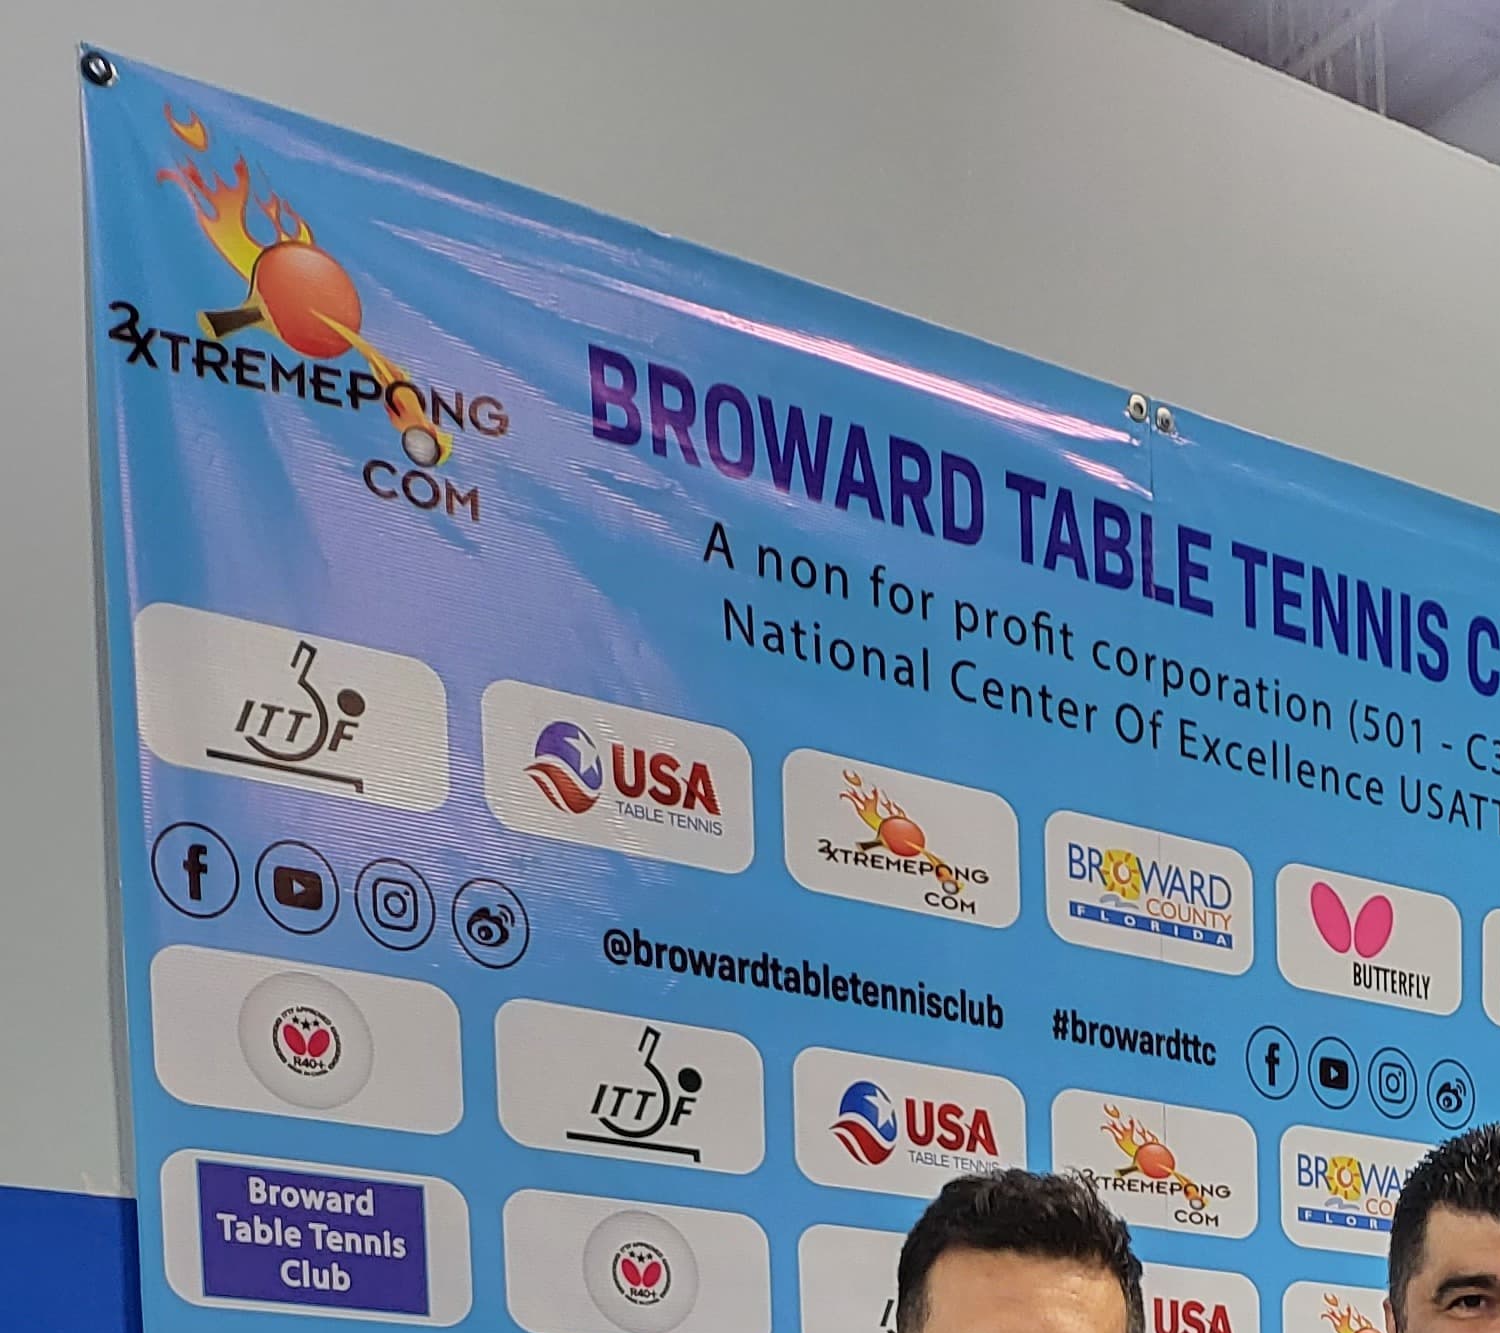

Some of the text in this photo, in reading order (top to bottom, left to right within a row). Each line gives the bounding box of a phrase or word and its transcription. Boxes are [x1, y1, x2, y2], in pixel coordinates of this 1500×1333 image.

[362, 459, 481, 522] COM
[587, 343, 985, 546] BROWARD
[1004, 469, 1214, 617] TABLE
[1231, 539, 1450, 682] TENNIS
[703, 522, 734, 569] A
[757, 543, 849, 598] non
[872, 565, 935, 620] for
[955, 598, 1074, 661] profit
[1092, 638, 1332, 730] corporation
[1348, 698, 1423, 755] (501
[724, 598, 930, 691] National
[950, 660, 1098, 733] Center
[1115, 701, 1163, 749] Of
[1180, 722, 1384, 806] Excellence
[612, 742, 722, 817] USA
[615, 800, 723, 837] TABLE TENNIS
[1068, 842, 1232, 911] BROWARD
[924, 891, 976, 915] COM
[1146, 898, 1232, 931] COUNTY
[1077, 905, 1228, 946] FLORIDA
[603, 928, 1217, 1067] @browardtabletennisclub #browardttc
[1352, 961, 1431, 1000] BUTTERFLY
[905, 1098, 999, 1157] USA
[908, 1150, 950, 1168] TABLE
[1298, 1153, 1412, 1197] BROWA
[248, 1176, 374, 1217] Broward
[216, 1212, 407, 1258] Table Tennis
[1174, 1209, 1219, 1228] COM
[1304, 1211, 1379, 1230] FLOR
[280, 1258, 352, 1292] Club
